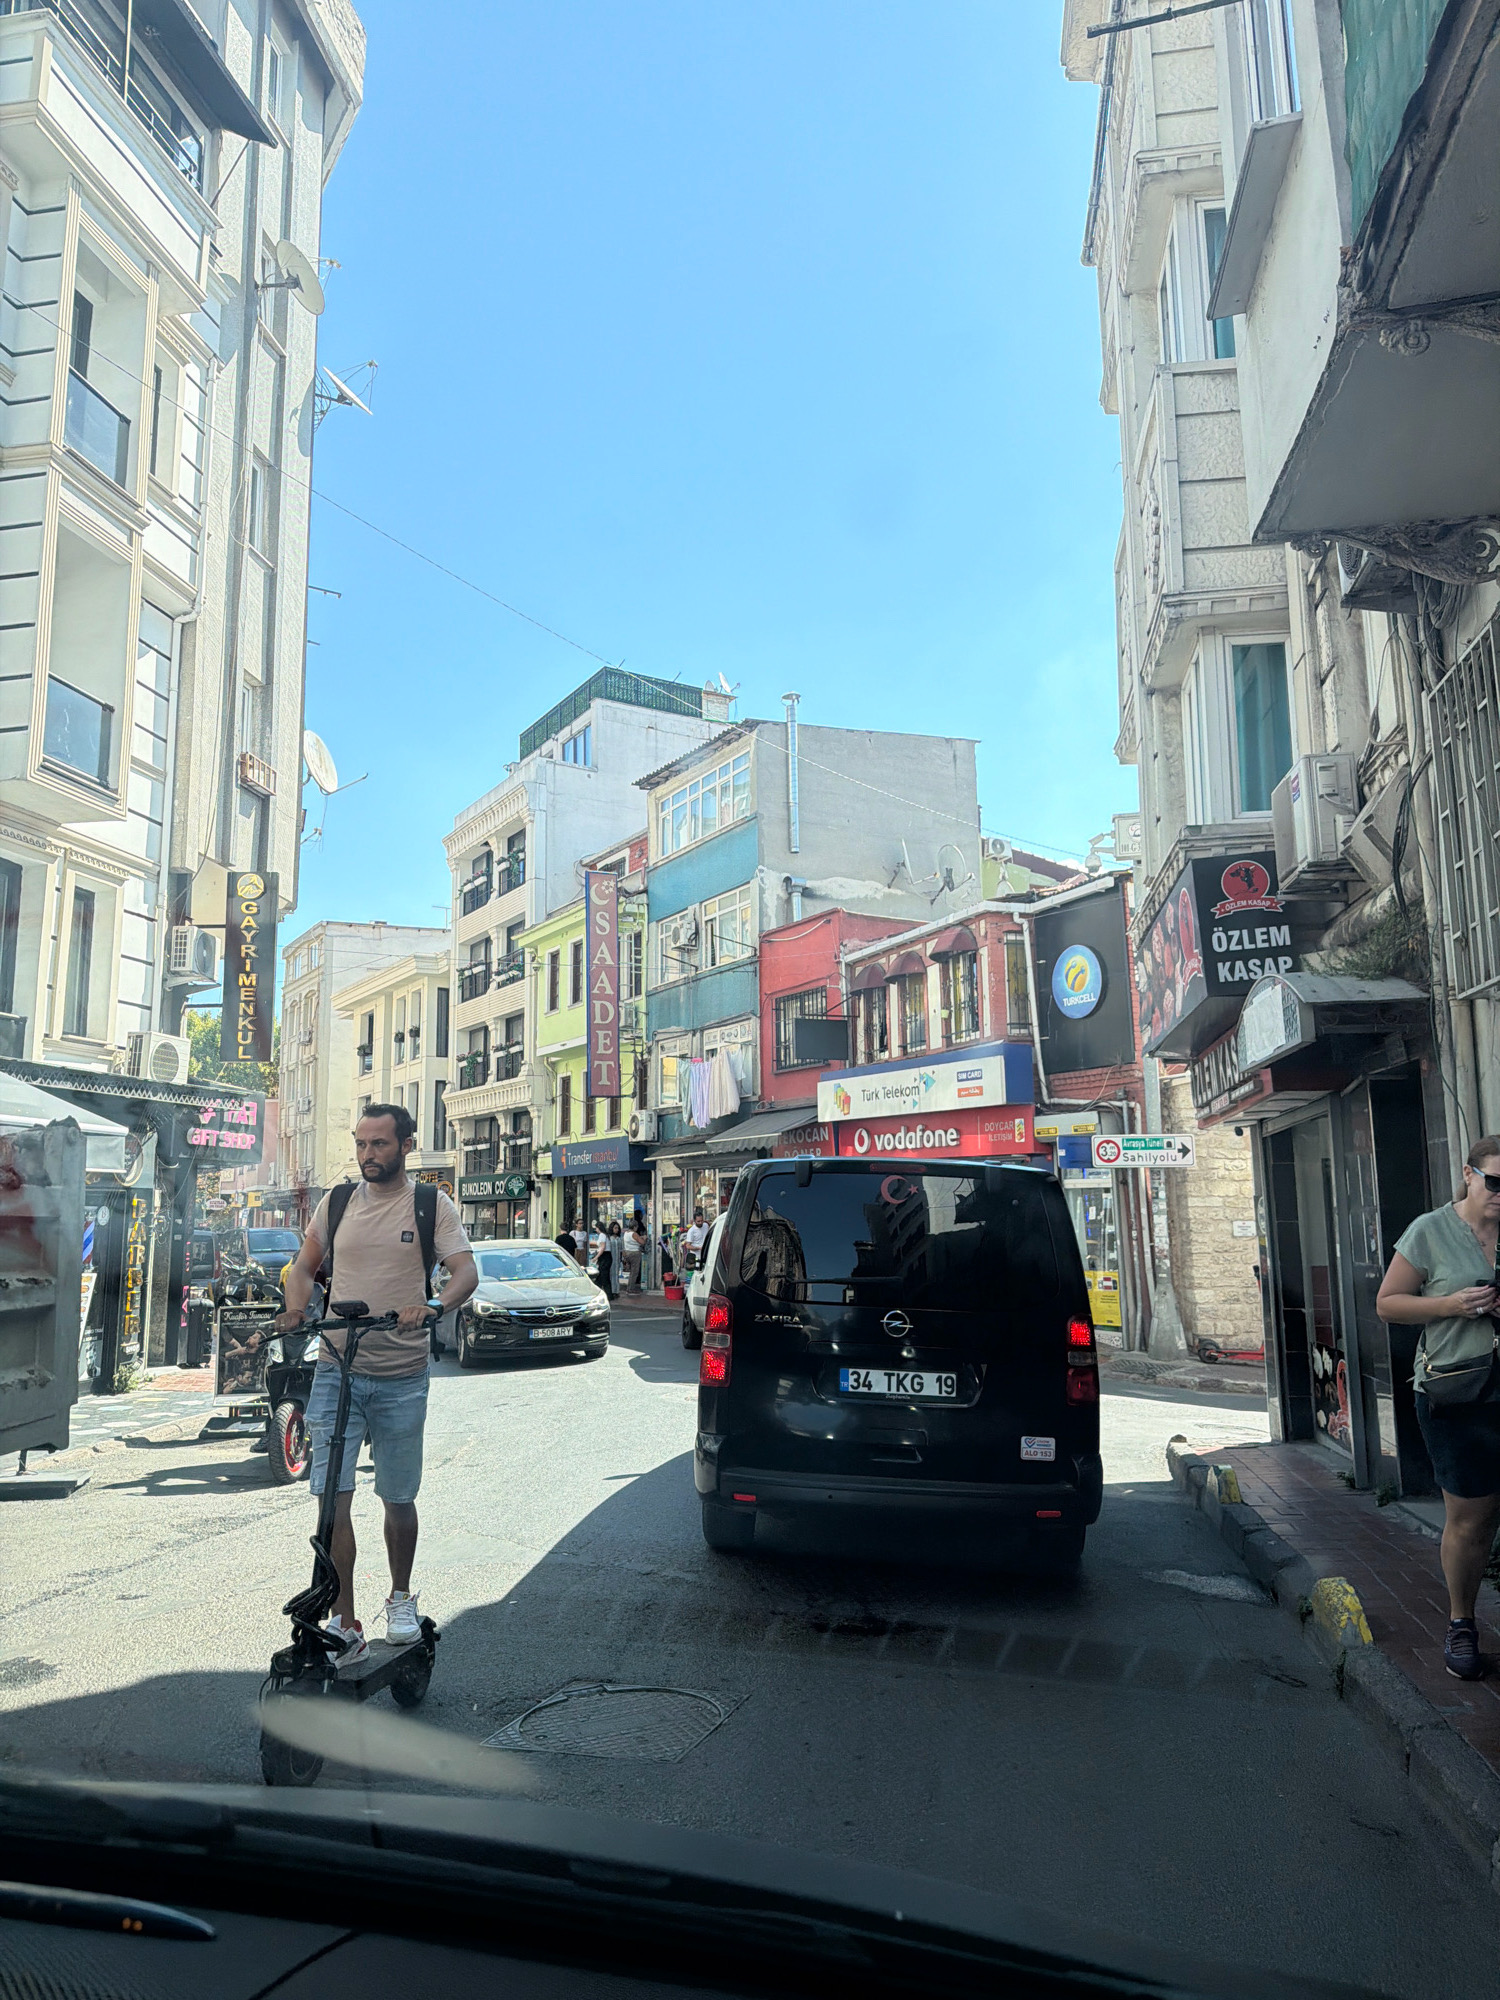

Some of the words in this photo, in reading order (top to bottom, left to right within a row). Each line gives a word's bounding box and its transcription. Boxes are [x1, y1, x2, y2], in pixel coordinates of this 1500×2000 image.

[1225, 900, 1247, 911] ÖZLEM
[1248, 899, 1271, 907] KASAP
[1211, 924, 1292, 953] ÖZLEM
[1217, 955, 1293, 983] KASAP
[957, 1071, 966, 1080] SIM
[967, 1070, 982, 1079] CARD
[861, 1088, 880, 1102] Türk
[881, 1085, 920, 1100] Telekom
[187, 1127, 220, 1147] GIFT
[219, 1131, 256, 1150] SHOP
[779, 1126, 829, 1145] EKOCAN
[873, 1124, 959, 1151] vodafone
[1123, 1138, 1145, 1149] Avrasya
[1145, 1138, 1164, 1148] Tüneli
[1122, 1152, 1177, 1164] Sahilyolu
[462, 1181, 493, 1197] BUKOLEON
[754, 1314, 802, 1324] ZAFIRA
[849, 1370, 873, 1391] 34
[883, 1372, 924, 1393] TKG
[935, 1375, 955, 1396] 19
[1040, 1450, 1052, 1458] 153
